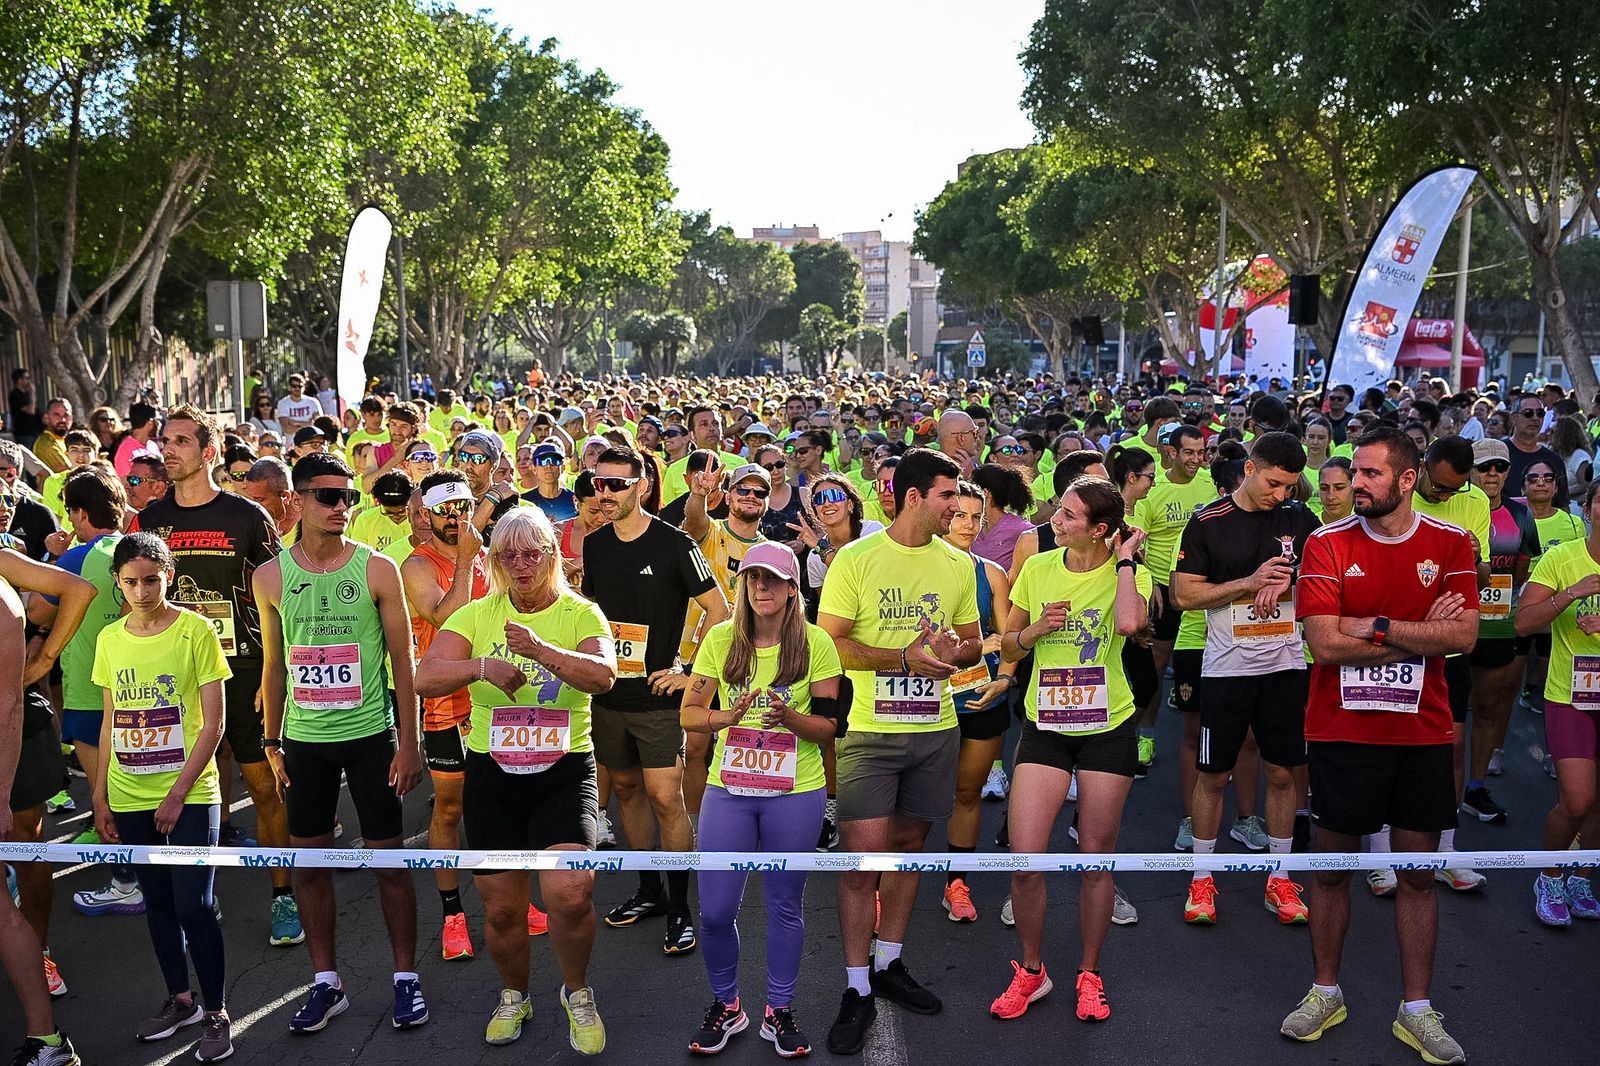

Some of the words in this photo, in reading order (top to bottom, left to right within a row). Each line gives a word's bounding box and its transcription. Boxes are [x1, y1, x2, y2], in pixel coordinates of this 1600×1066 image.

[1373, 262, 1416, 283] ALMERÍA
[1166, 502, 1182, 512] XII
[1166, 511, 1193, 522] MUJE
[376, 536, 392, 545] XII
[878, 587, 902, 603] XII
[879, 605, 924, 619] MUJER
[116, 667, 136, 685] XII
[298, 664, 352, 685] 2316
[1354, 664, 1413, 685] 1858
[115, 686, 160, 702] MUJER
[885, 677, 935, 697] 1132
[1046, 686, 1097, 706] 1387
[496, 714, 522, 722] MUJER
[120, 726, 172, 748] 1927
[501, 726, 560, 748] 2014
[729, 734, 751, 743] MUJER
[731, 747, 787, 772] 2007
[77, 848, 134, 864] NEXAL
[240, 852, 296, 867] NEXAL
[323, 853, 374, 862] COOPERACIÓN
[651, 858, 701, 867] COOPERACIÓN
[1475, 859, 1525, 867] COOPERACIÓN
[979, 860, 1029, 869] COOPERACIÓN
[1144, 861, 1194, 869] COOPERACIÓN
[1309, 860, 1360, 869] COOPERACIÓN
